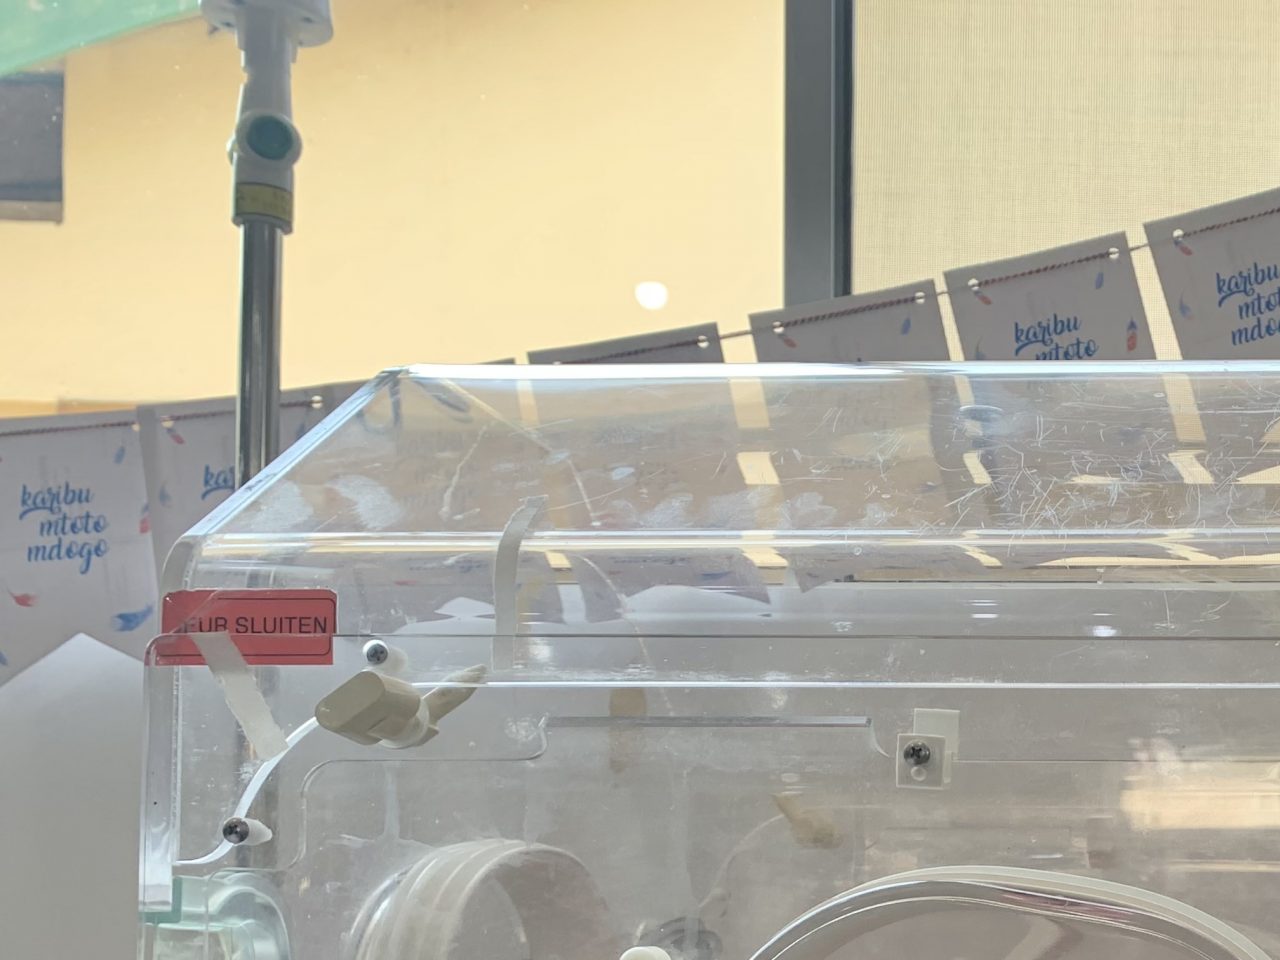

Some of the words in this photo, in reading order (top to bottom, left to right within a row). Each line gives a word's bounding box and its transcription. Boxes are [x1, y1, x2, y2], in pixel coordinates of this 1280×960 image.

[1014, 313, 1081, 357] karibu
[19, 480, 94, 520] karibu
[39, 511, 109, 537] mtoto
[27, 537, 109, 575] mdogo
[235, 616, 327, 634] SLUITEN
